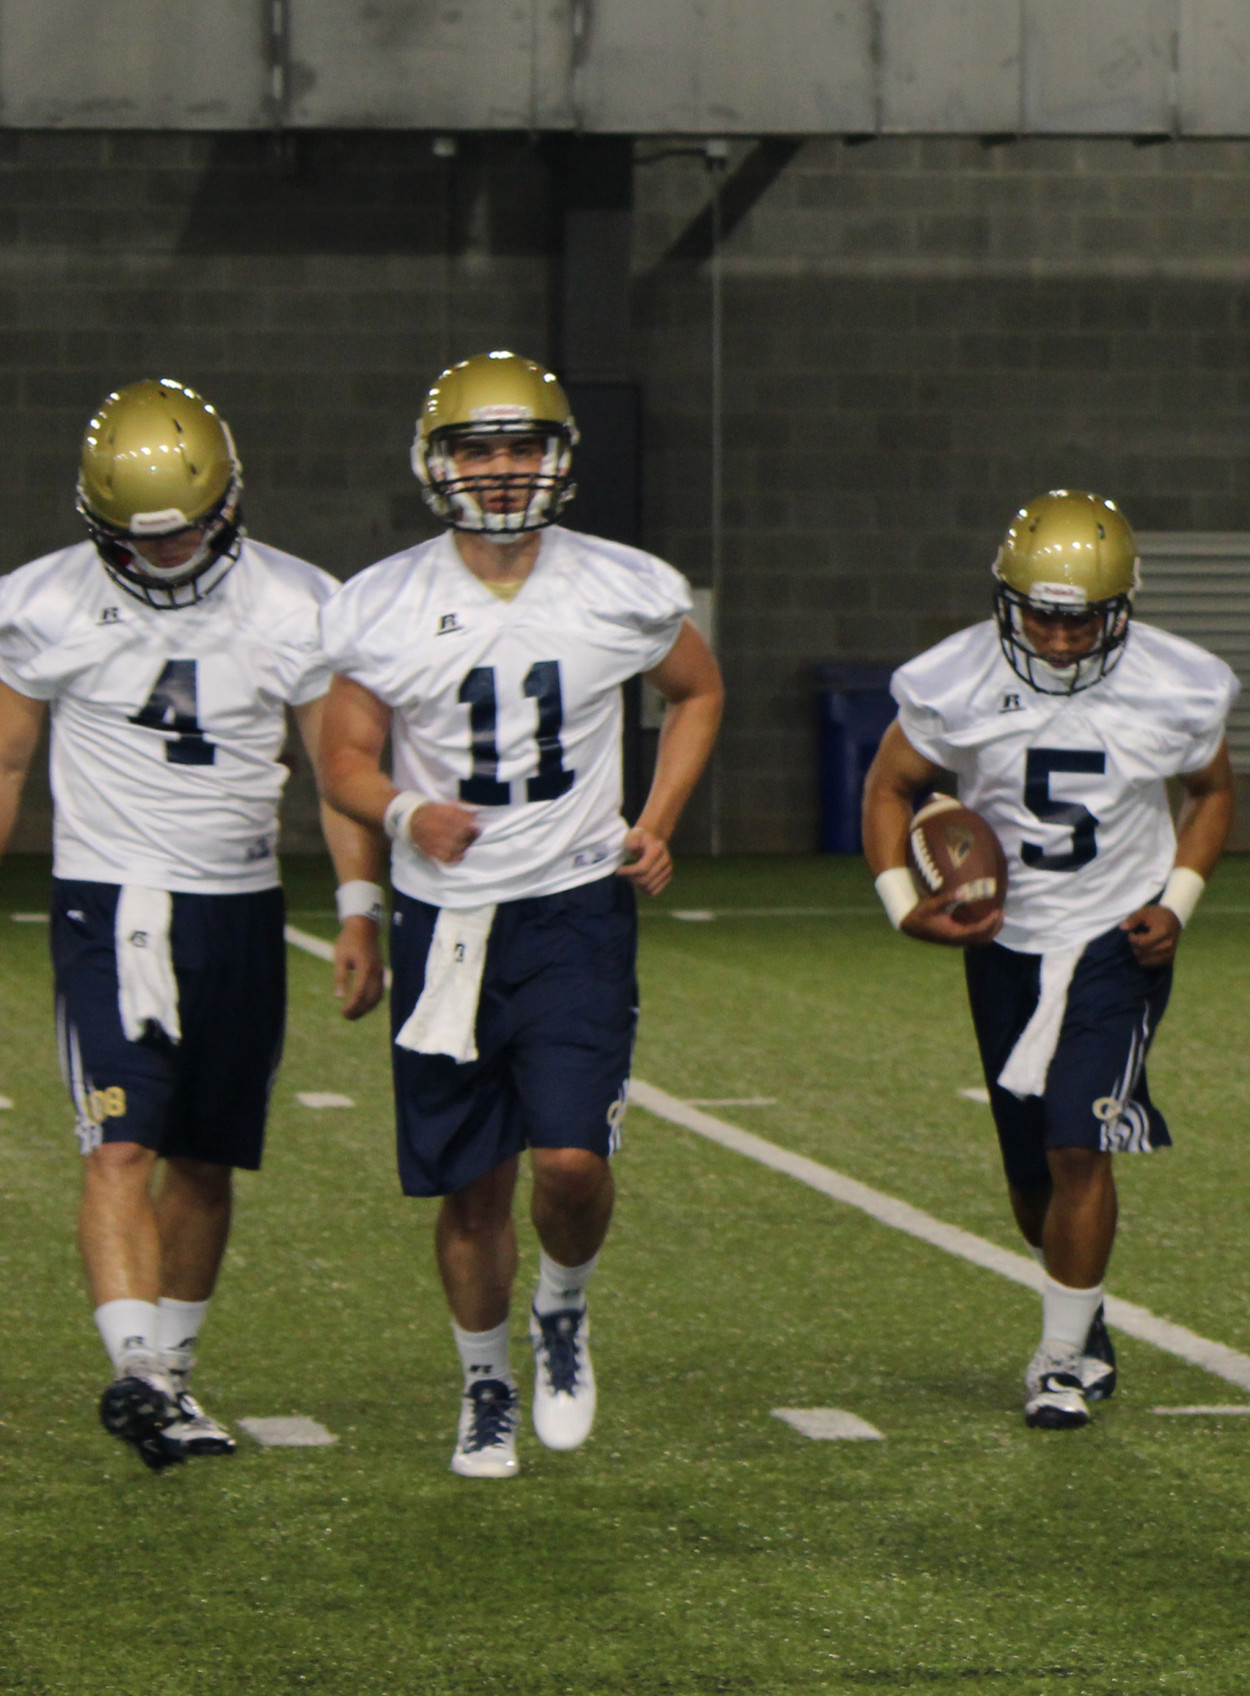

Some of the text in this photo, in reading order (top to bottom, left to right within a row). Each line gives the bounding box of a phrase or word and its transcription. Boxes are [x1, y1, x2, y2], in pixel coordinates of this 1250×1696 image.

[126, 659, 216, 766] 4
[457, 660, 575, 806] 11
[1020, 747, 1106, 873] 5
